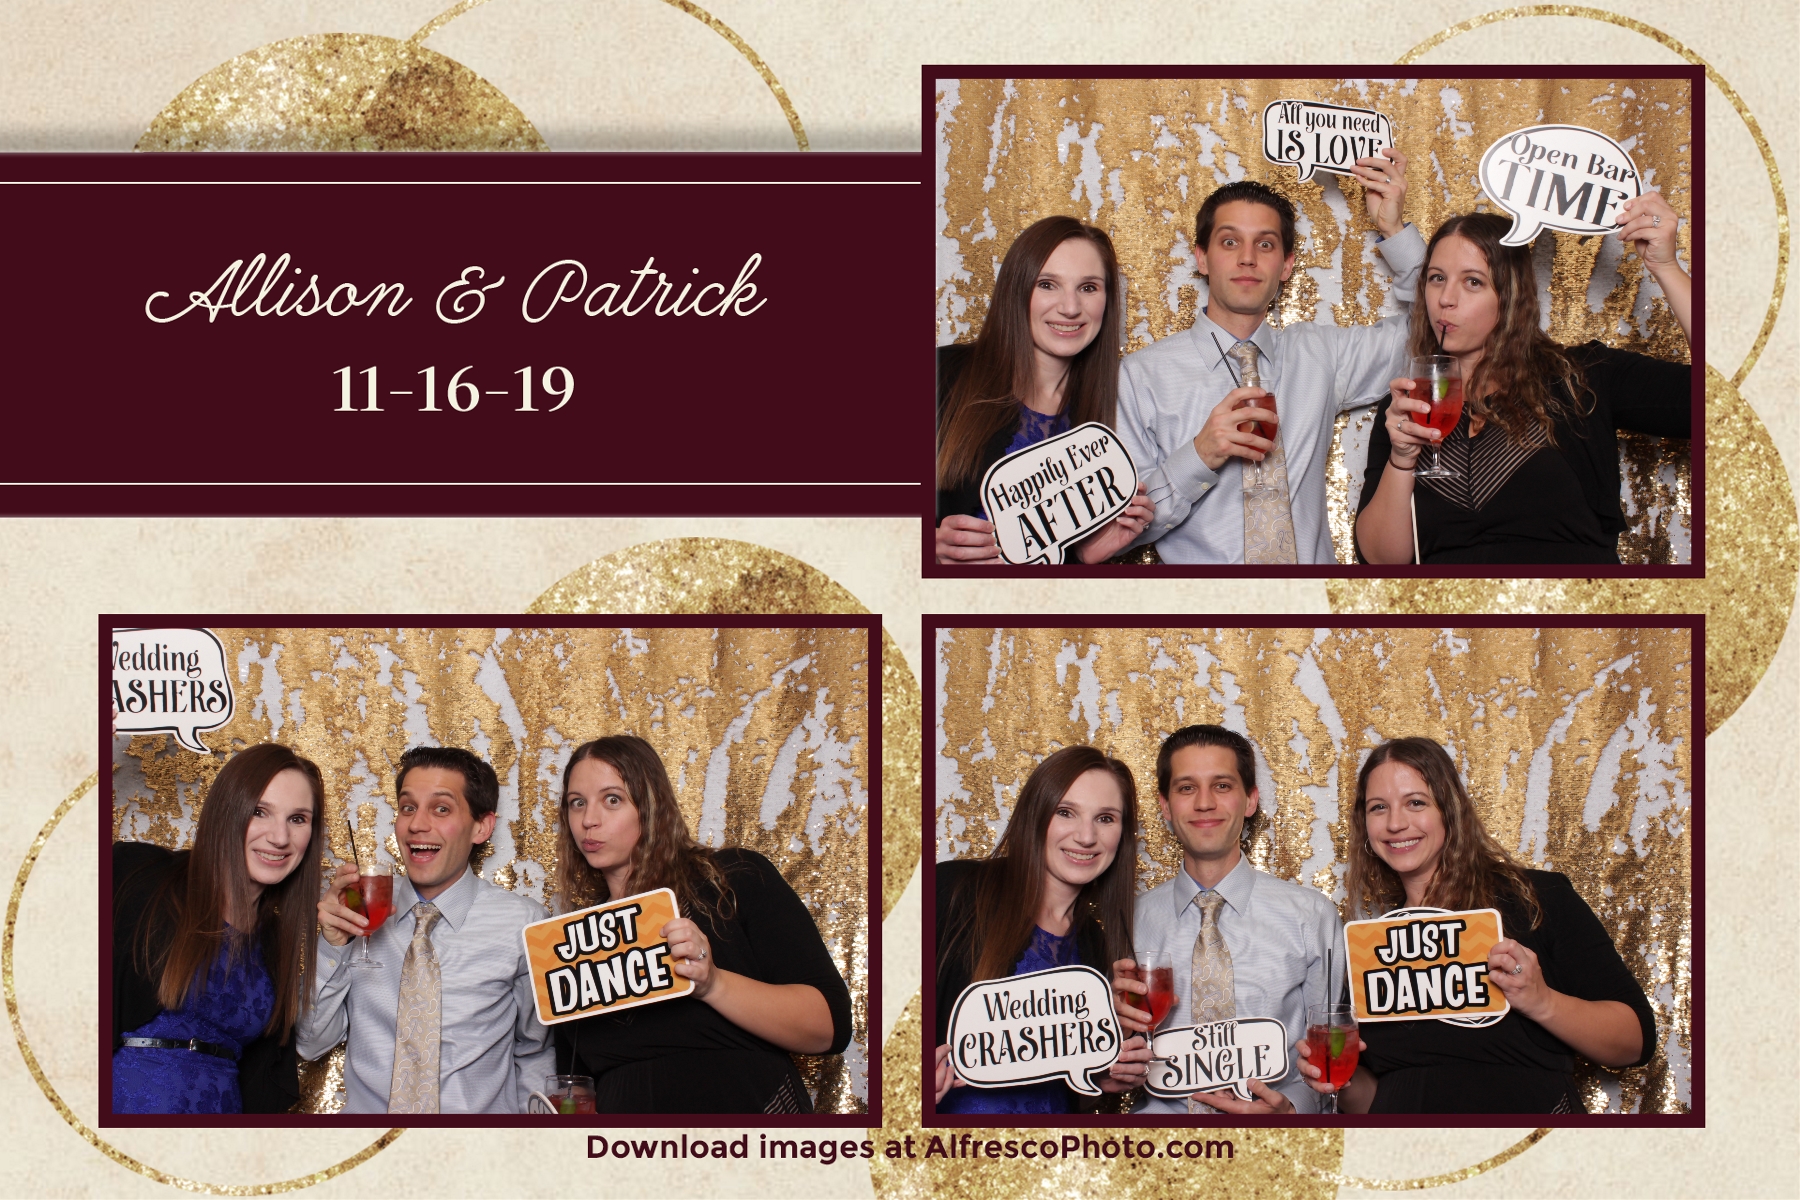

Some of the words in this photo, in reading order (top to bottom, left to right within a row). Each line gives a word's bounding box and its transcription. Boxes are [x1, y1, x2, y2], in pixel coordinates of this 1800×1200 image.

[1278, 103, 1302, 124] All
[1305, 112, 1336, 133] you
[1342, 114, 1380, 133] need
[1277, 129, 1305, 161] IS
[1511, 134, 1578, 169] Open
[1586, 153, 1636, 183] Bar
[990, 457, 1069, 512] Happily
[1065, 435, 1109, 471] Ever
[1017, 466, 1127, 560] AFTER
[556, 905, 640, 961] JUST
[1377, 921, 1464, 964] JUST
[547, 944, 671, 1014] DANCE
[1366, 963, 1487, 1013] DANCE
[983, 988, 1090, 1022] Wedding
[959, 1018, 1116, 1069] CRASHERS
[1192, 1021, 1238, 1050] Still
[1162, 1044, 1272, 1087] SINGLE
